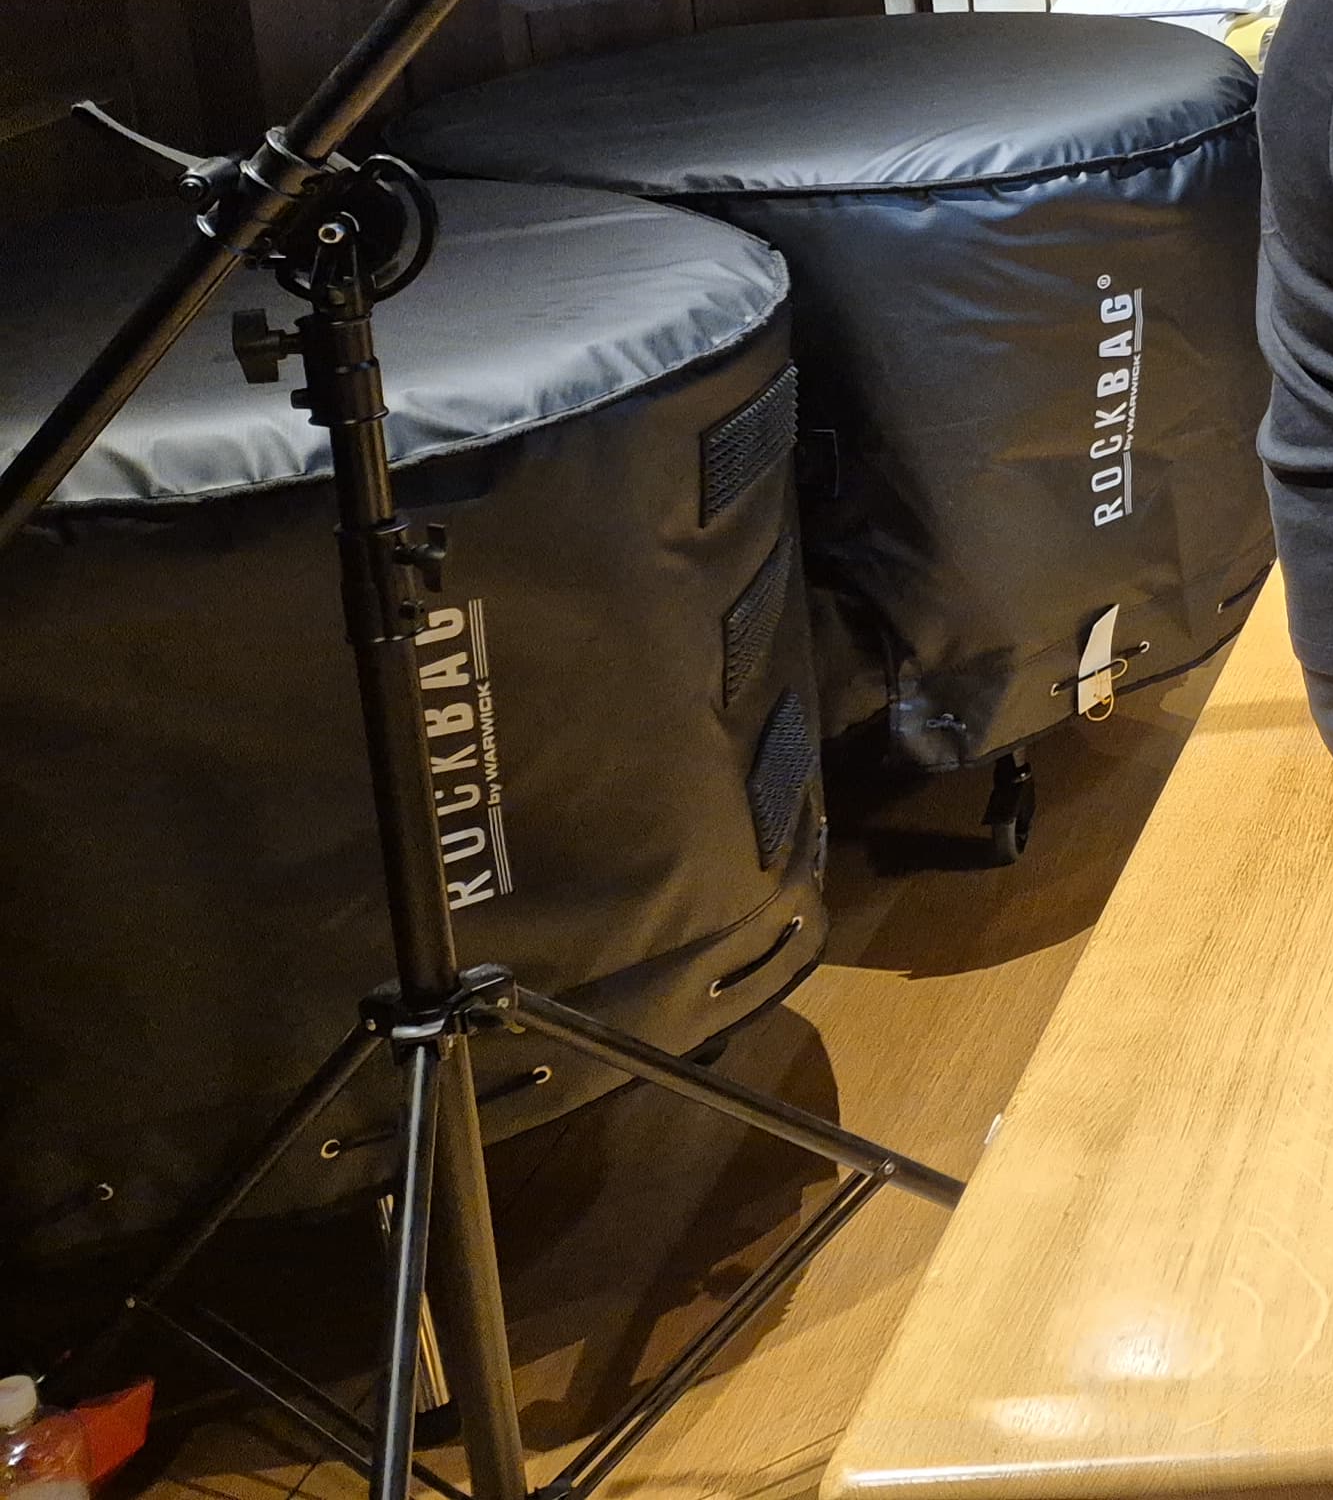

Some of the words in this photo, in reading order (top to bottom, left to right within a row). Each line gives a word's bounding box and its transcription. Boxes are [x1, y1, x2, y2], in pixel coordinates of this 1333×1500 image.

[1128, 353, 1141, 431] WARWICK
[477, 681, 498, 782] WARWICK
[488, 783, 502, 805] by
